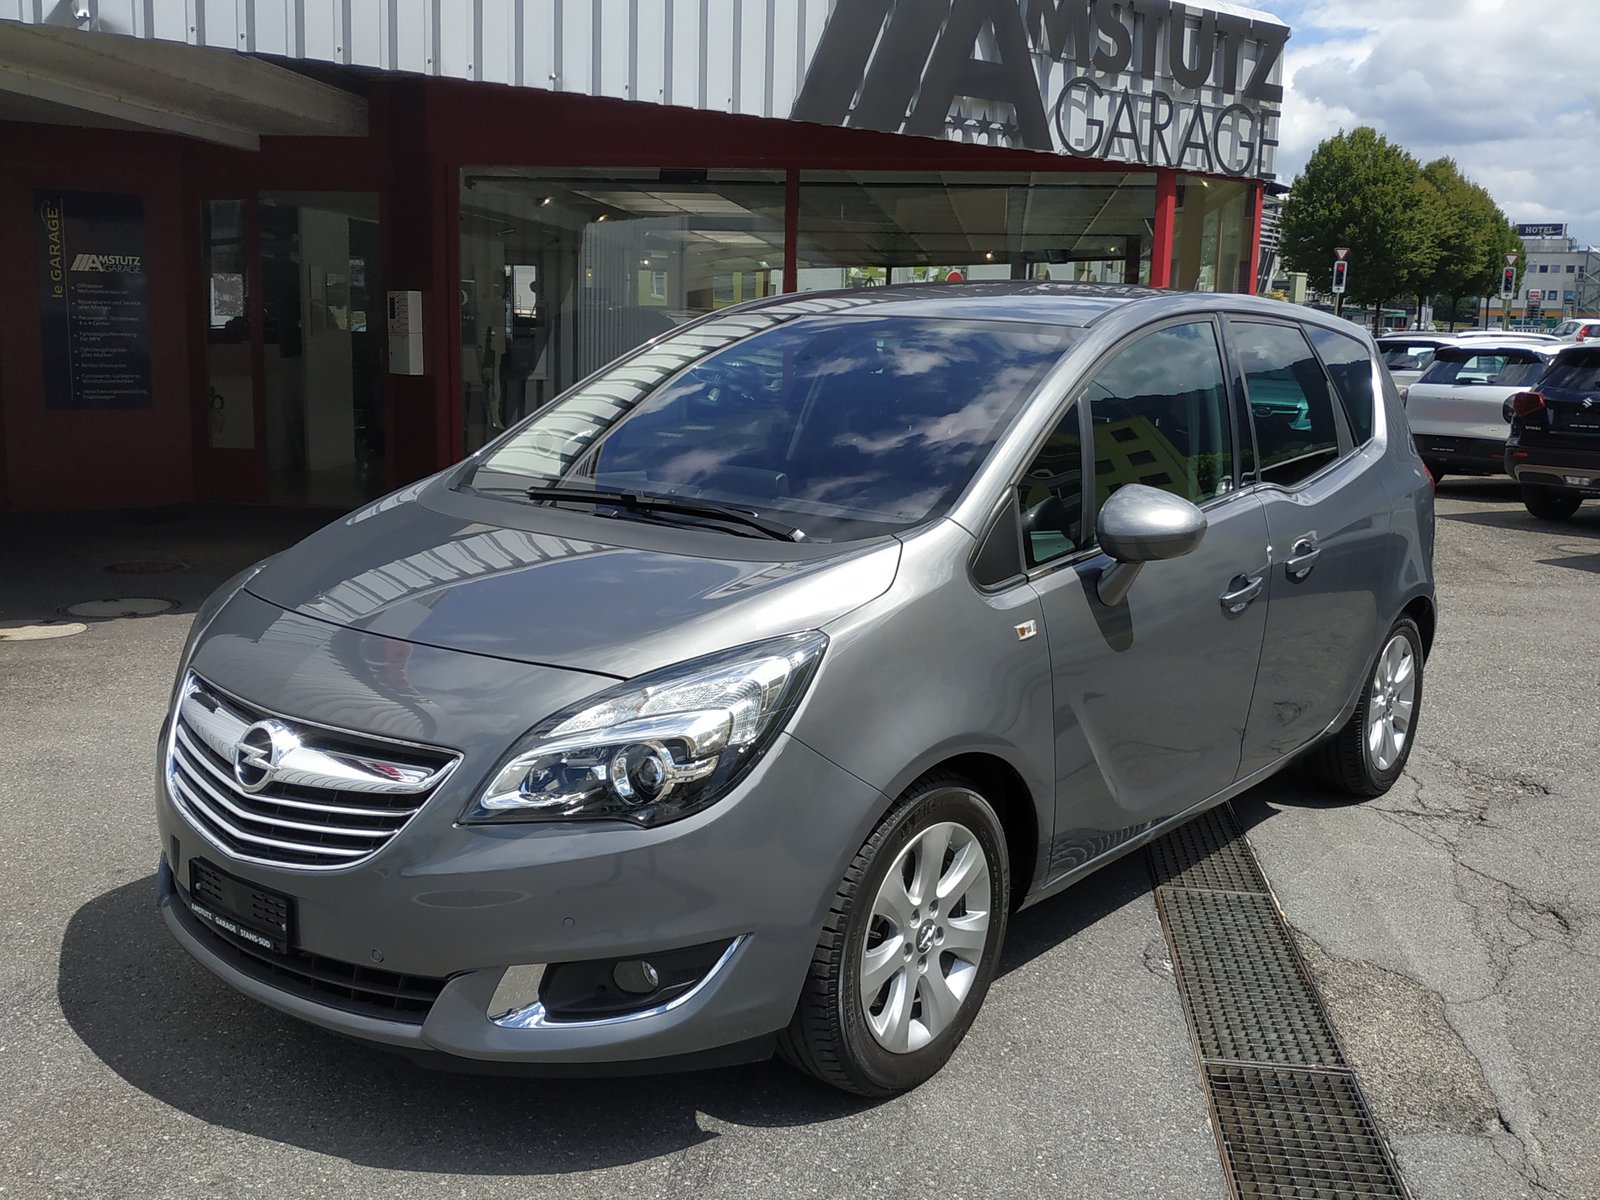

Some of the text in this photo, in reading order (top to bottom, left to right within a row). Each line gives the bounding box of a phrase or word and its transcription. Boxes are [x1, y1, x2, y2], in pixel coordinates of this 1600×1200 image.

[902, 0, 1291, 151] AMSTUTZ
[1055, 77, 1281, 179] GARAGE
[1525, 226, 1553, 234] HOTEL
[48, 207, 63, 298] le GARAGE
[86, 254, 141, 271] AMSTUTZ
[103, 264, 141, 273] GARAGE
[191, 903, 212, 920] AMSTUTZ
[215, 917, 236, 934] GARAGE
